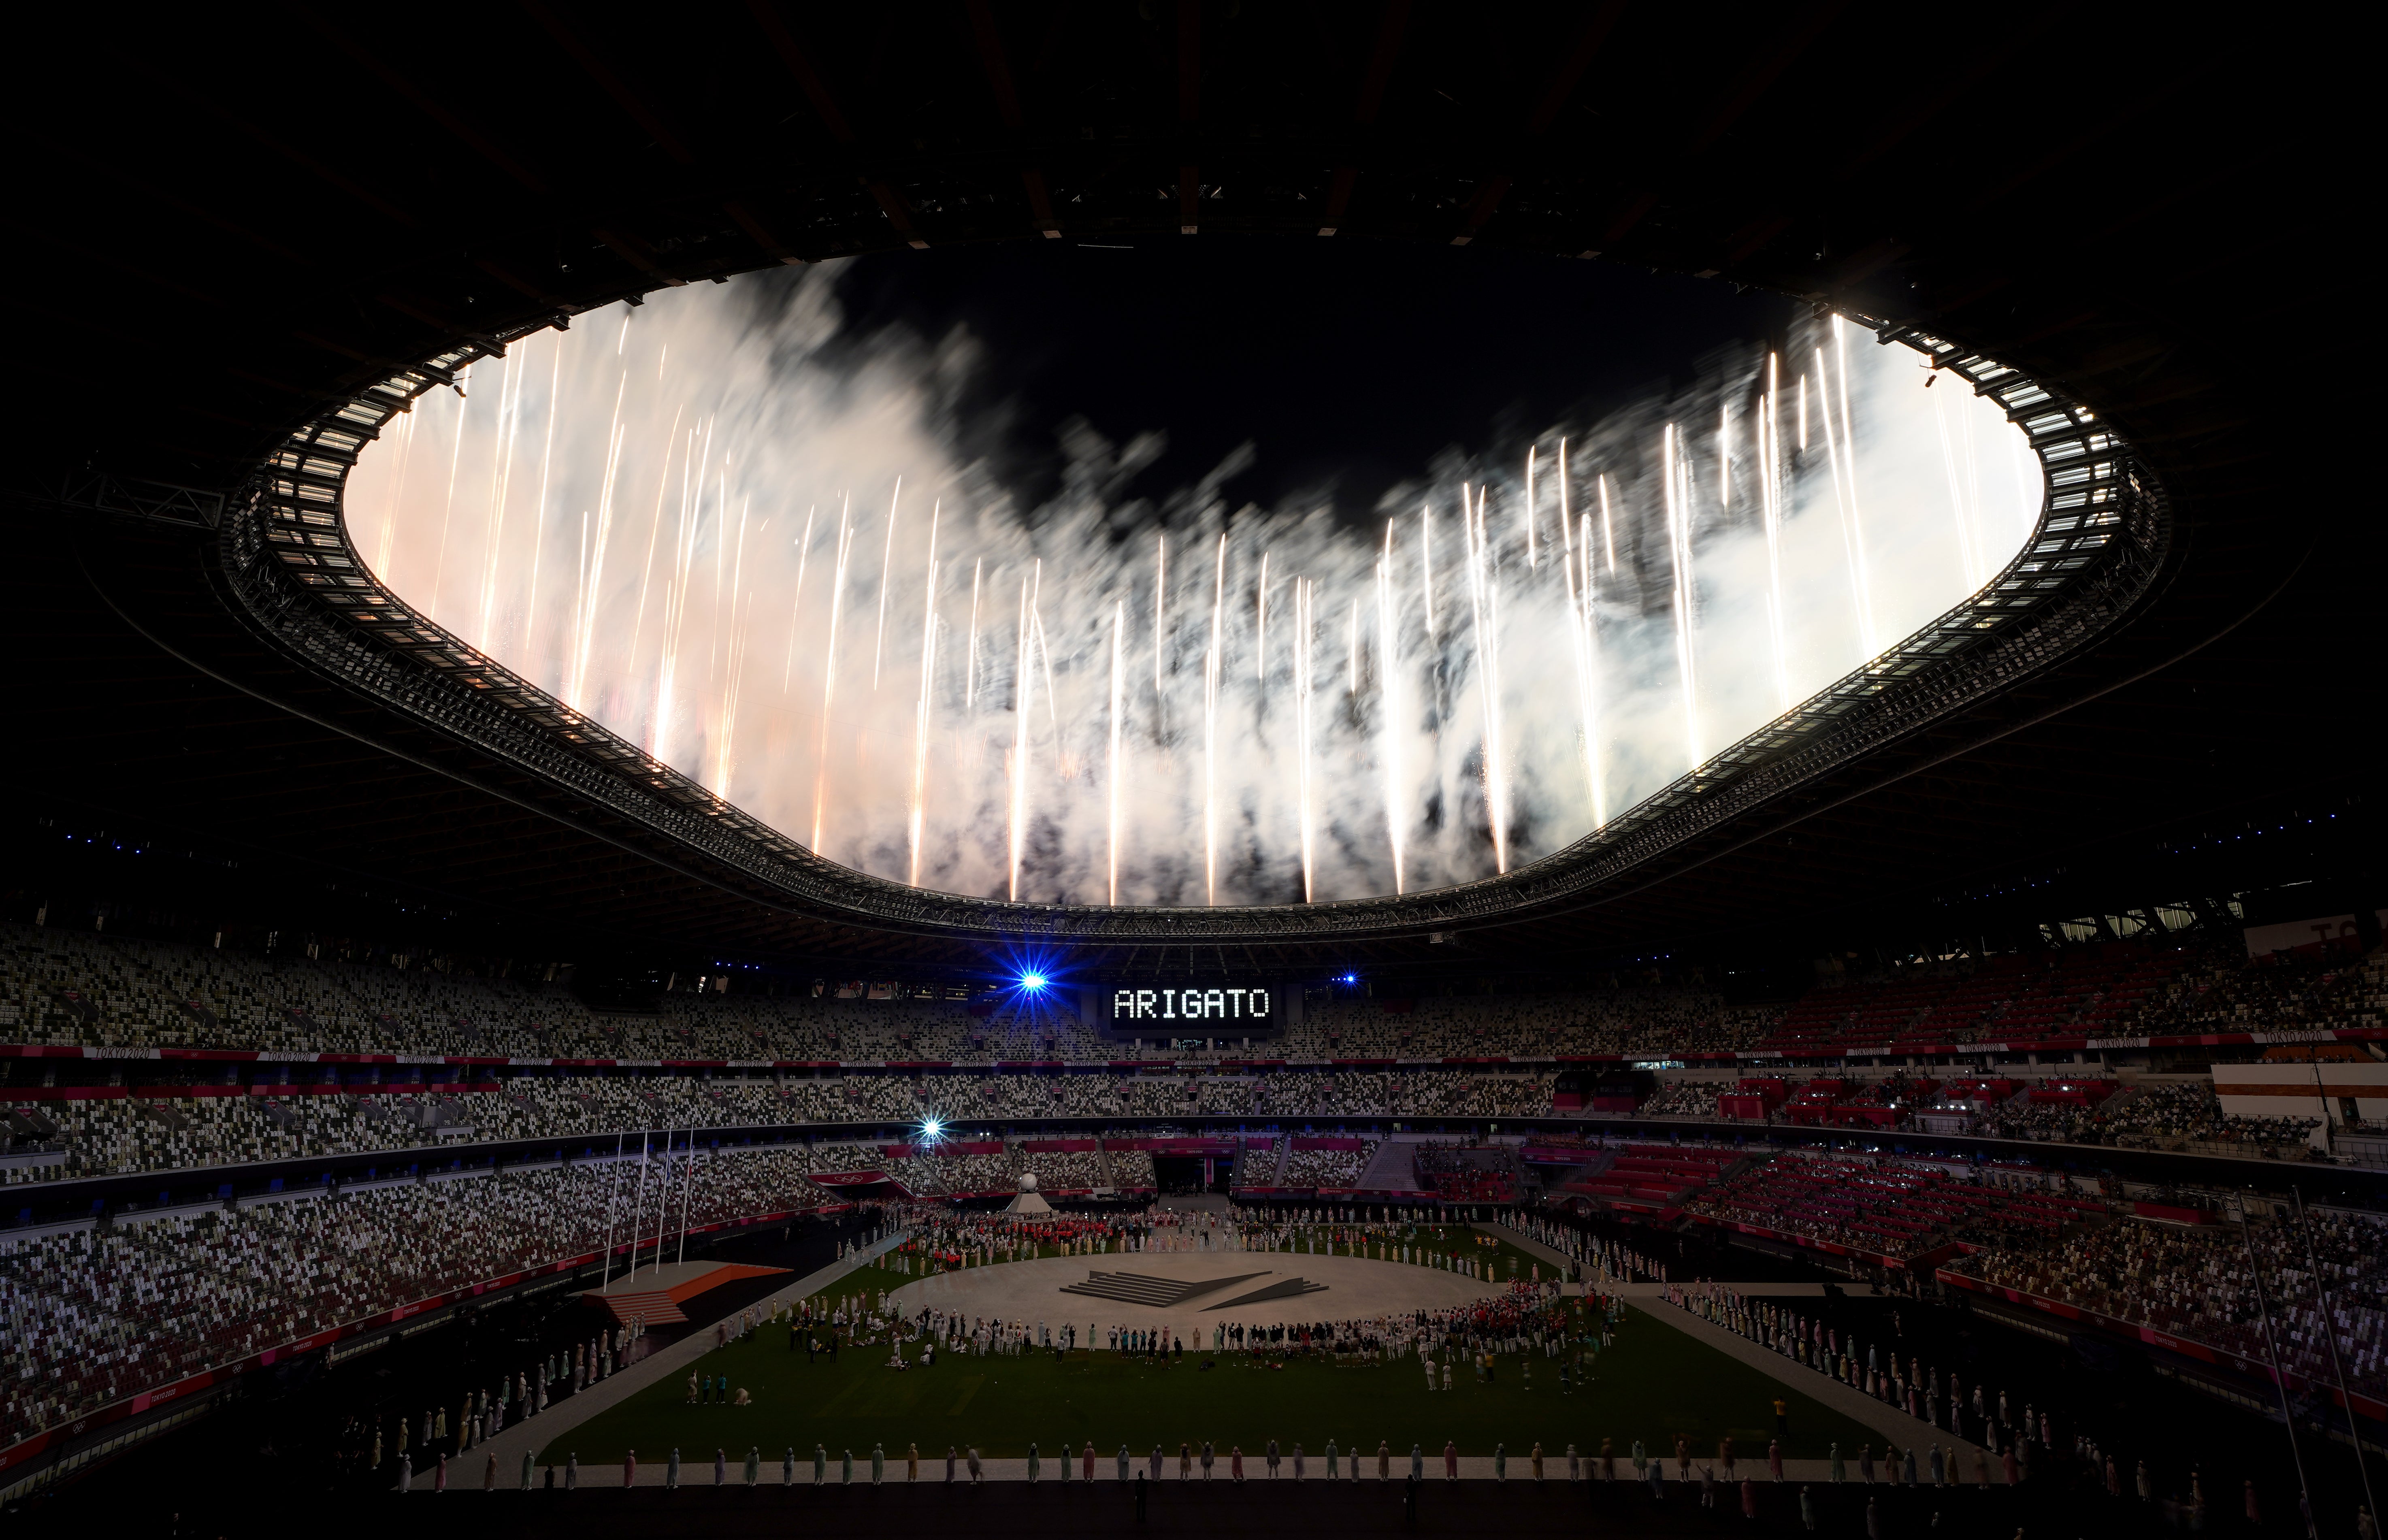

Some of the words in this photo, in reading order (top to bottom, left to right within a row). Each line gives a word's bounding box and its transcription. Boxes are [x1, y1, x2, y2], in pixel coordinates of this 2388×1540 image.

[1115, 989, 1269, 1018] ARIGATO
[2264, 1032, 2295, 1043] TOKYO
[2298, 1031, 2322, 1041] 2020
[1964, 1044, 1984, 1052] TOKYO
[1985, 1044, 2000, 1052] 2020
[2095, 1039, 2120, 1048] TOKYO
[2122, 1038, 2139, 1048] 2020
[96, 1048, 126, 1059] TOKYO
[128, 1048, 149, 1059] 2020
[269, 1052, 291, 1061] TOKYO
[293, 1052, 310, 1061] 2020
[2155, 1336, 2167, 1344] TOKYO
[2167, 1340, 2177, 1348] 2020
[293, 1344, 304, 1352] TOKYO
[151, 1392, 165, 1403] TOKYO
[165, 1388, 176, 1397] 2020
